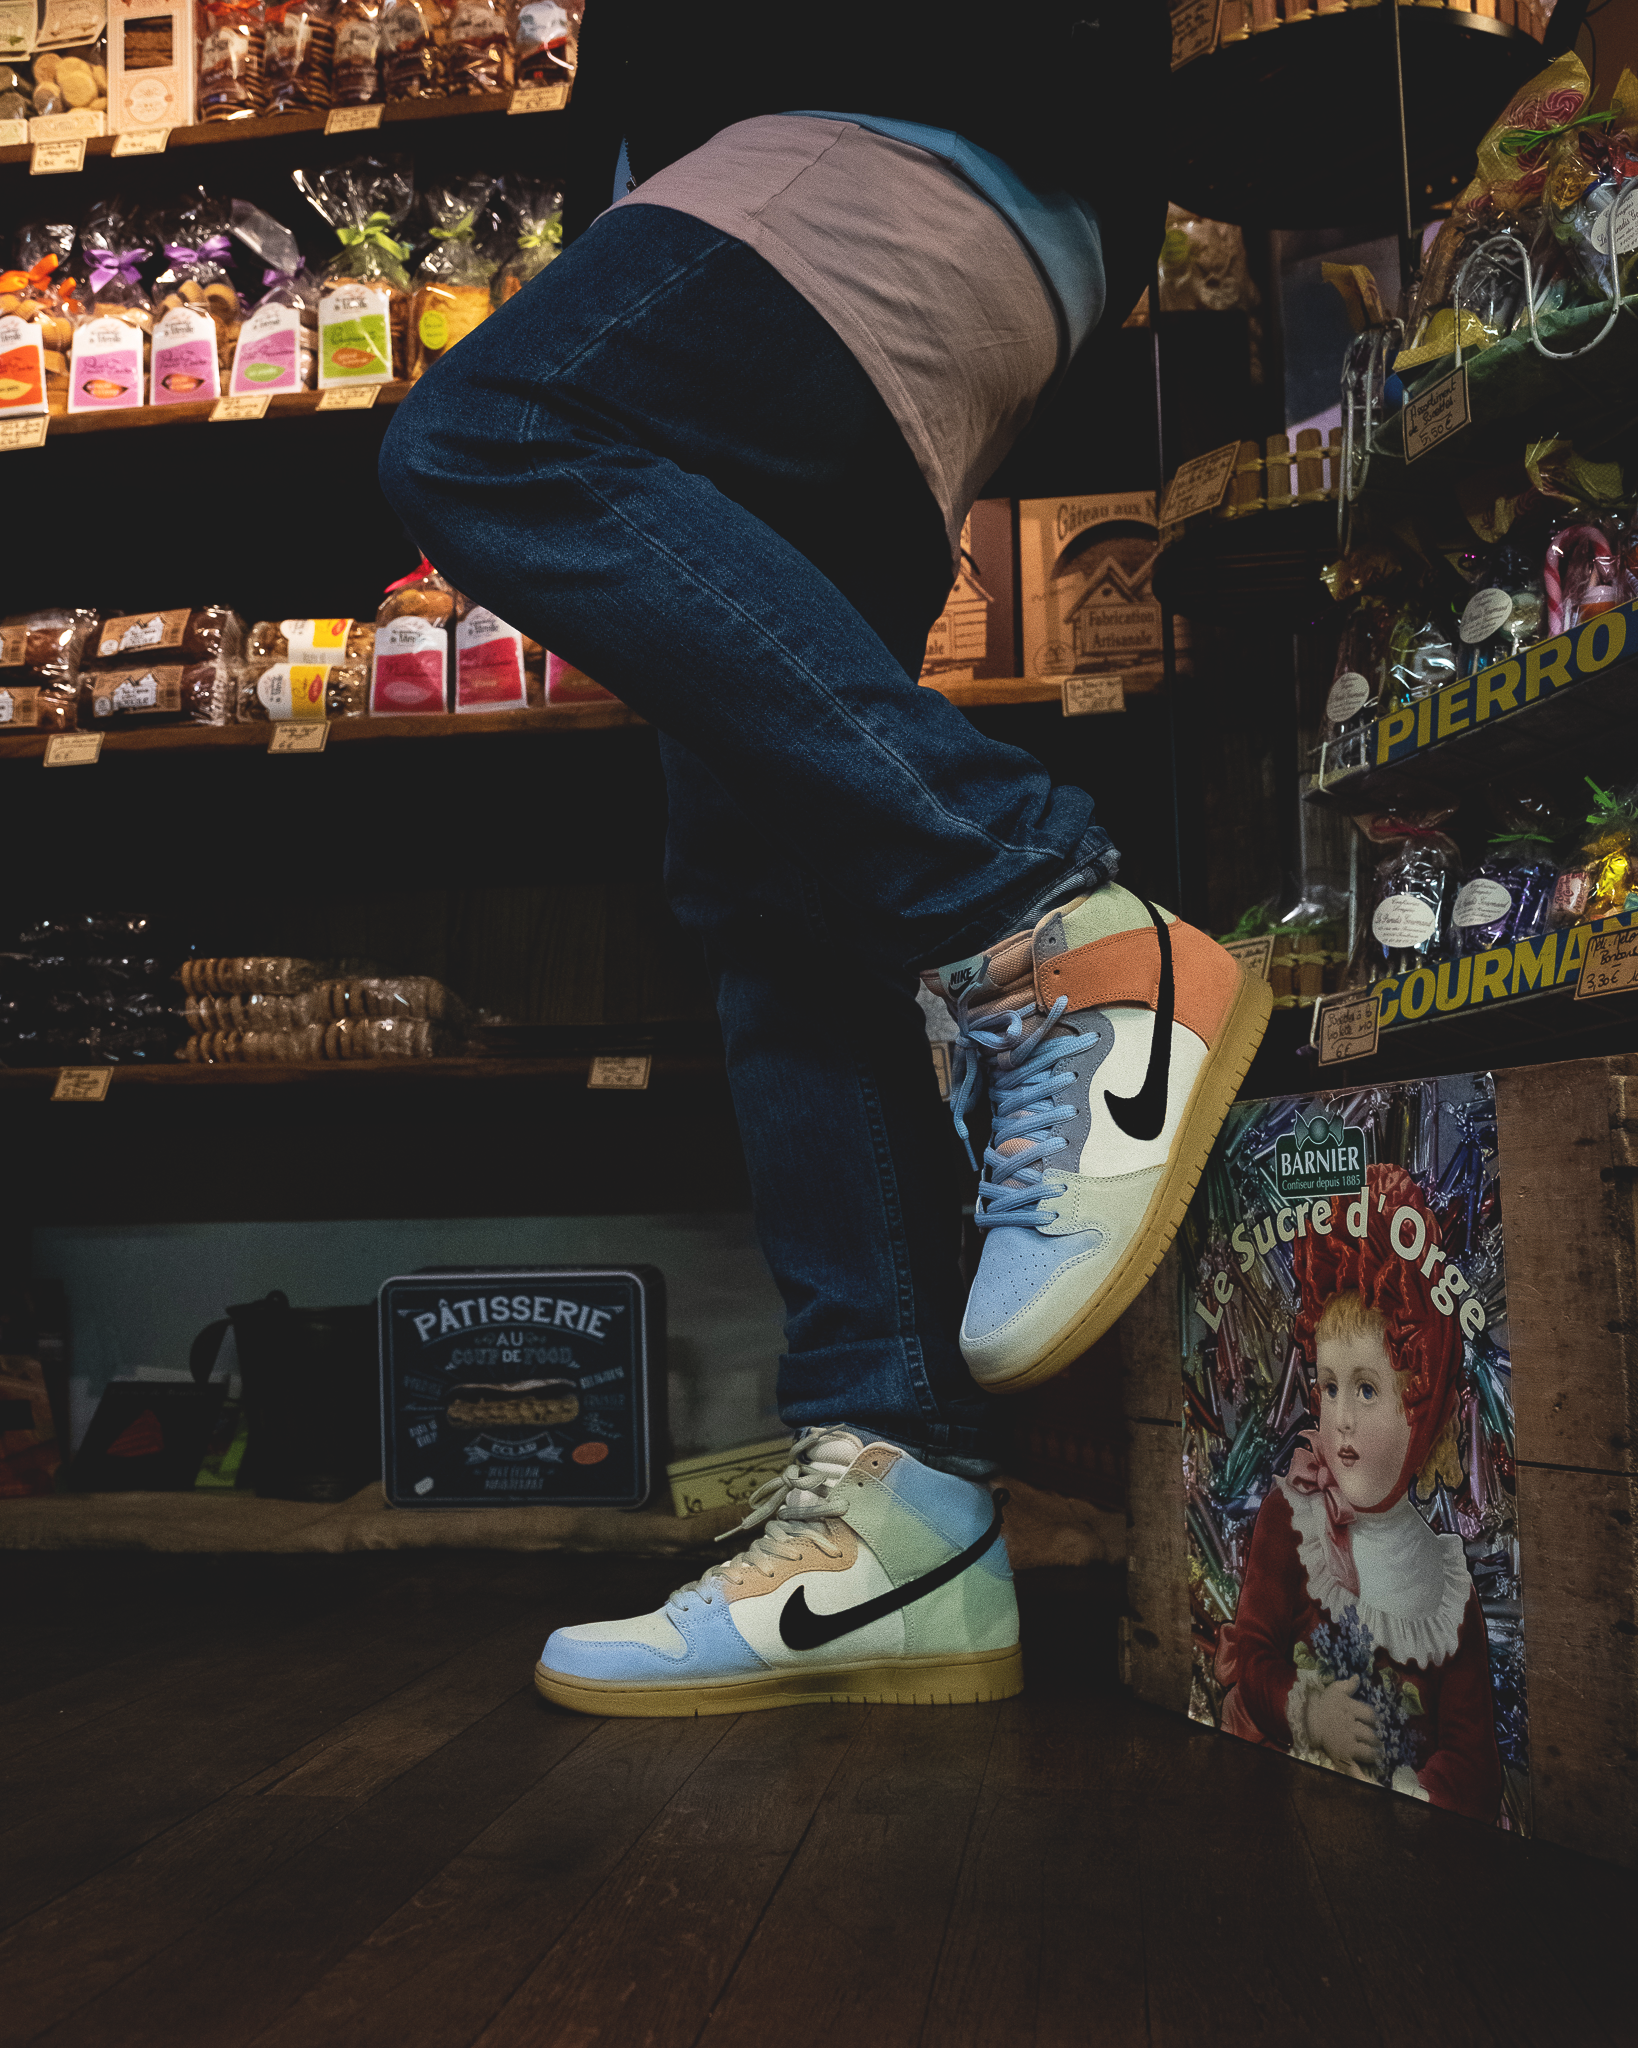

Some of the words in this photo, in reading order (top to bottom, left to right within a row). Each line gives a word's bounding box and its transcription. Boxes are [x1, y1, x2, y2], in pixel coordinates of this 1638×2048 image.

[1089, 610, 1155, 626] Fabrication
[1092, 632, 1152, 648] Artisanale
[1376, 598, 1638, 766] PIERRO
[950, 967, 972, 985] NIKE
[1281, 1146, 1360, 1176] BARNIER
[1282, 1178, 1314, 1191] Confiseur
[1316, 1176, 1340, 1191] depuis
[1342, 1174, 1360, 1187] 1885
[1195, 1270, 1234, 1333] Le
[1231, 1200, 1333, 1273] Sucre
[413, 1295, 611, 1342] PÂTISSERIE
[496, 1331, 524, 1347] AU
[502, 1349, 523, 1363] DE
